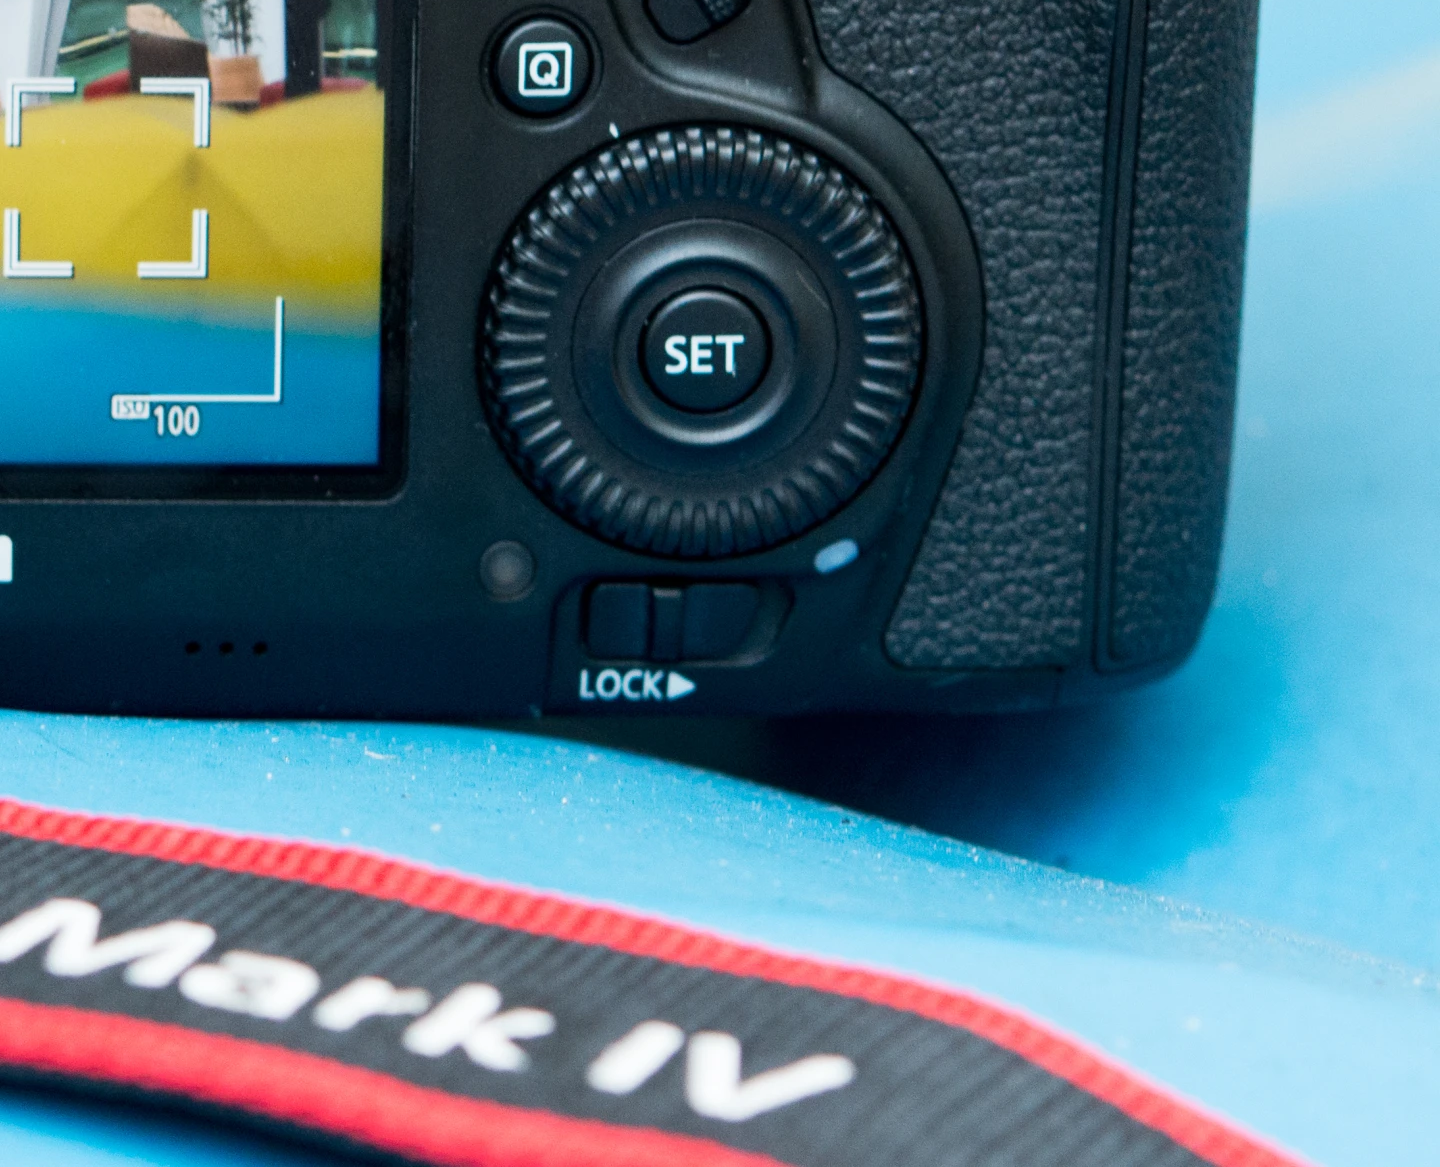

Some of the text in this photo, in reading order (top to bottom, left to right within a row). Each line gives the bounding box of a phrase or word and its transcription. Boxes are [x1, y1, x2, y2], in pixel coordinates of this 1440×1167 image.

[529, 52, 560, 87] Q
[664, 334, 745, 375] SET
[116, 397, 200, 437] ISO 100
[579, 668, 664, 701] LOCK
[586, 1020, 856, 1122] IV
